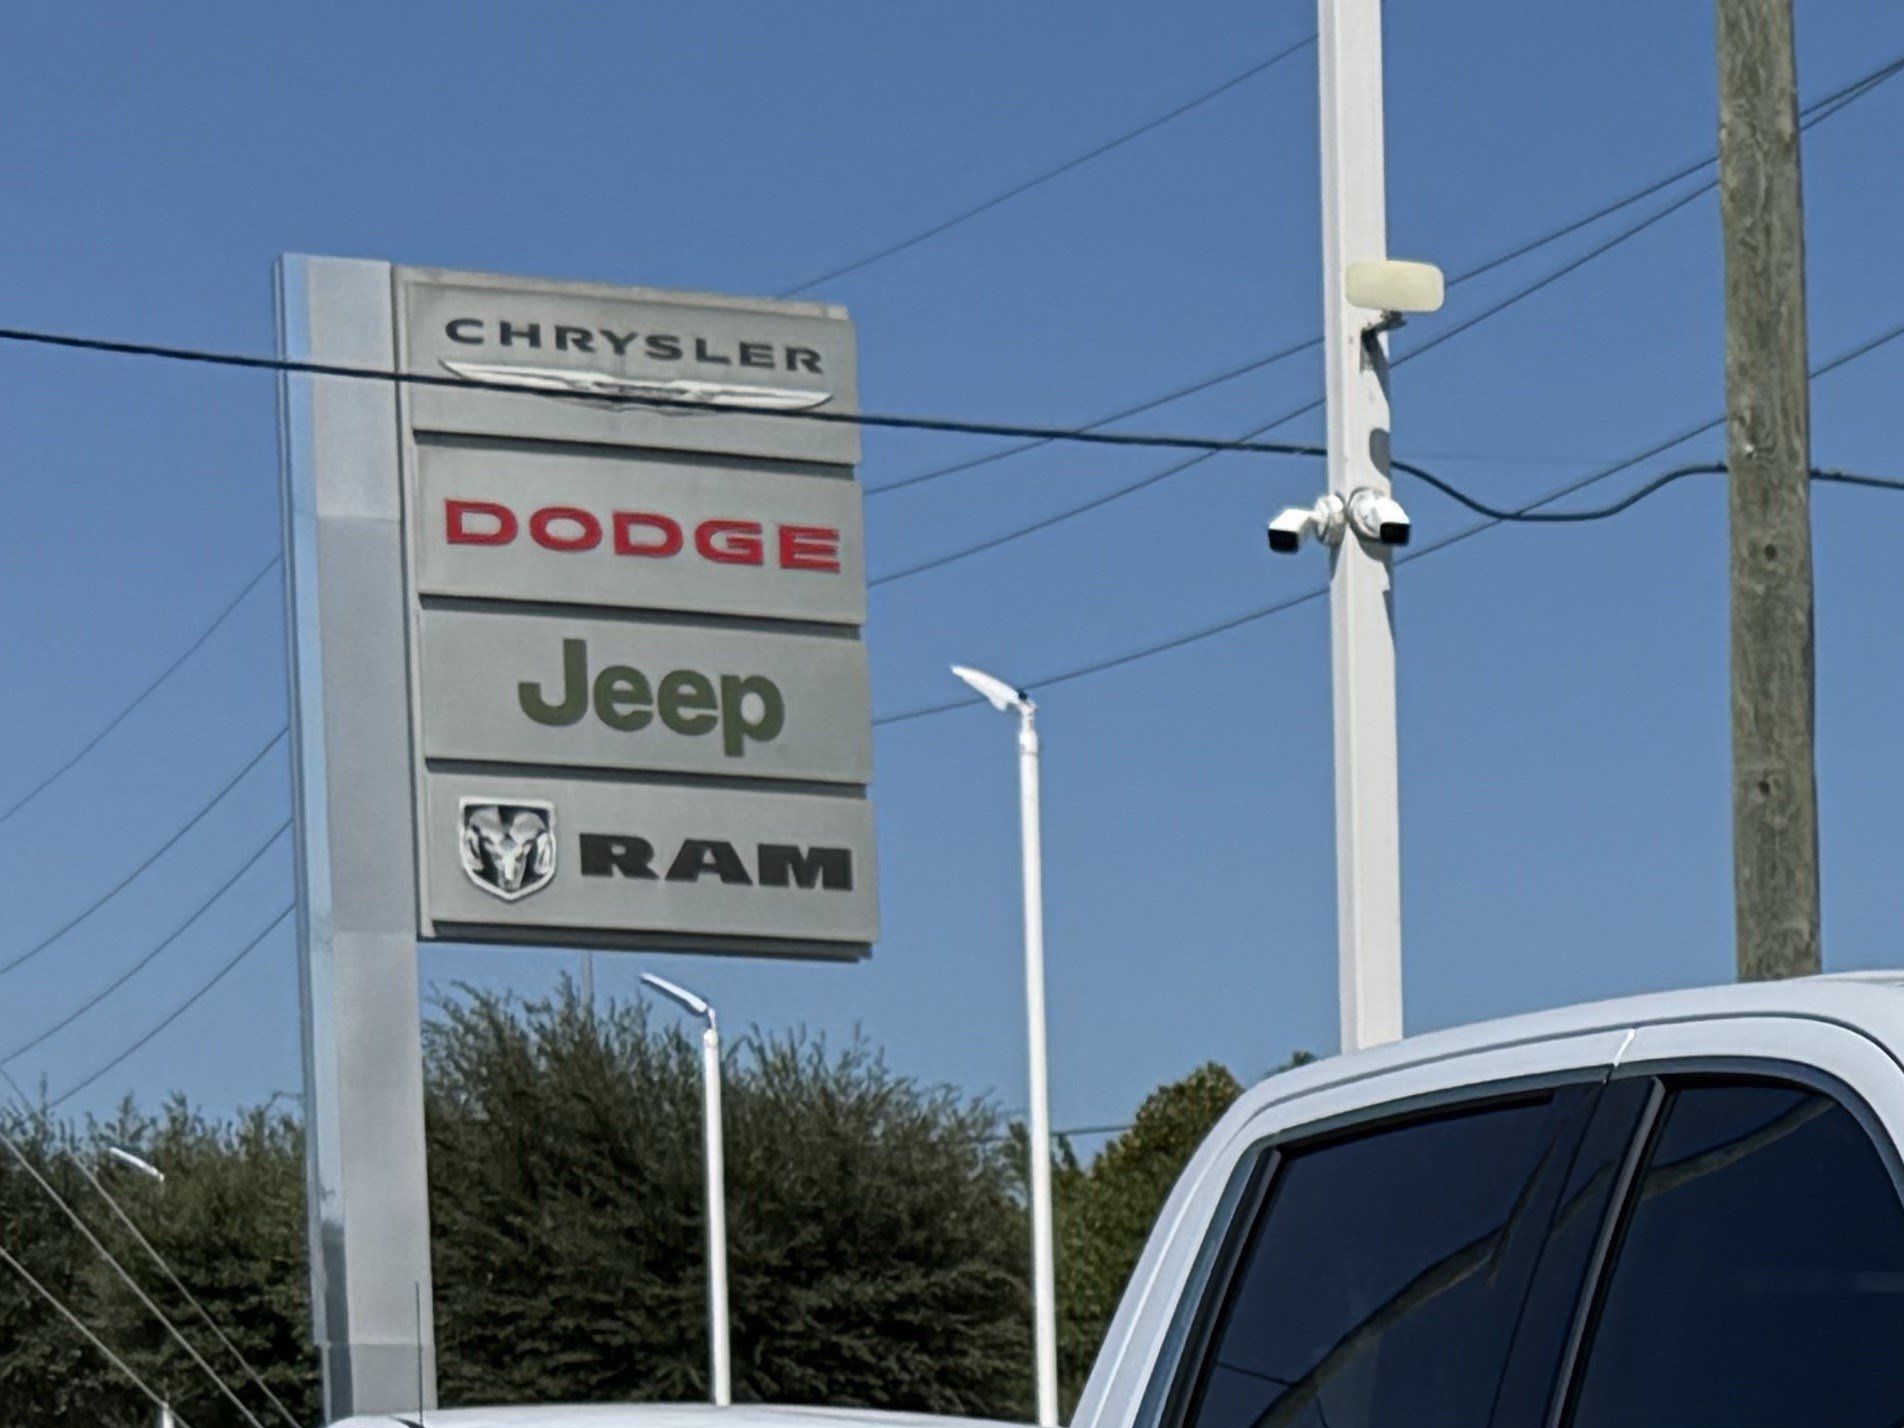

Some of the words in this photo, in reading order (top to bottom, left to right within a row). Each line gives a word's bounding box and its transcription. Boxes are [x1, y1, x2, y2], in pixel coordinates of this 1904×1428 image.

[445, 318, 824, 374] CHRYSLER
[444, 498, 840, 573] DODGE
[518, 638, 785, 757] Jeep
[579, 833, 853, 892] RAM
